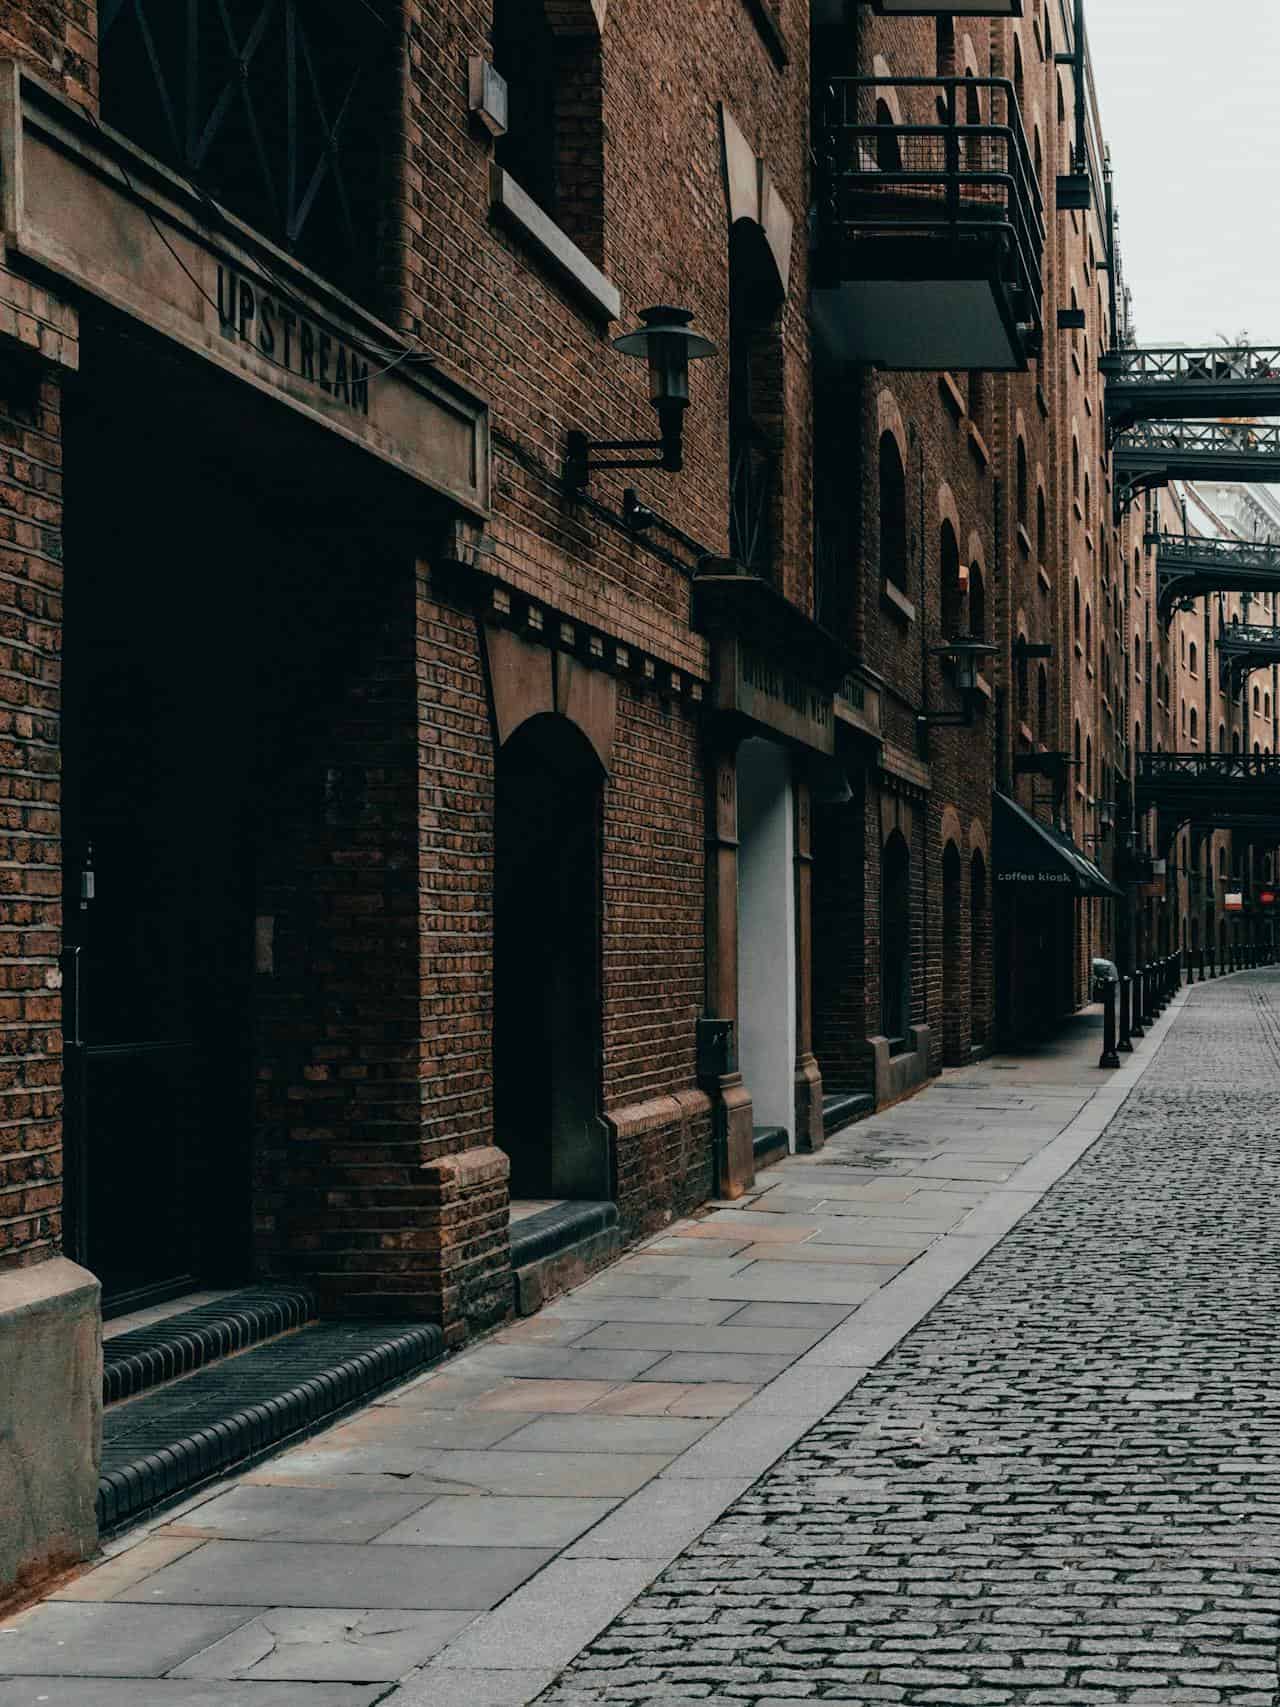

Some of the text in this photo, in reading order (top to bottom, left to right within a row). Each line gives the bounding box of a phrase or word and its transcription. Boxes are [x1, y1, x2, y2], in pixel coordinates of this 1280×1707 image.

[216, 264, 369, 416] UPSTREAM
[997, 871, 1072, 883] coffee kiosk
